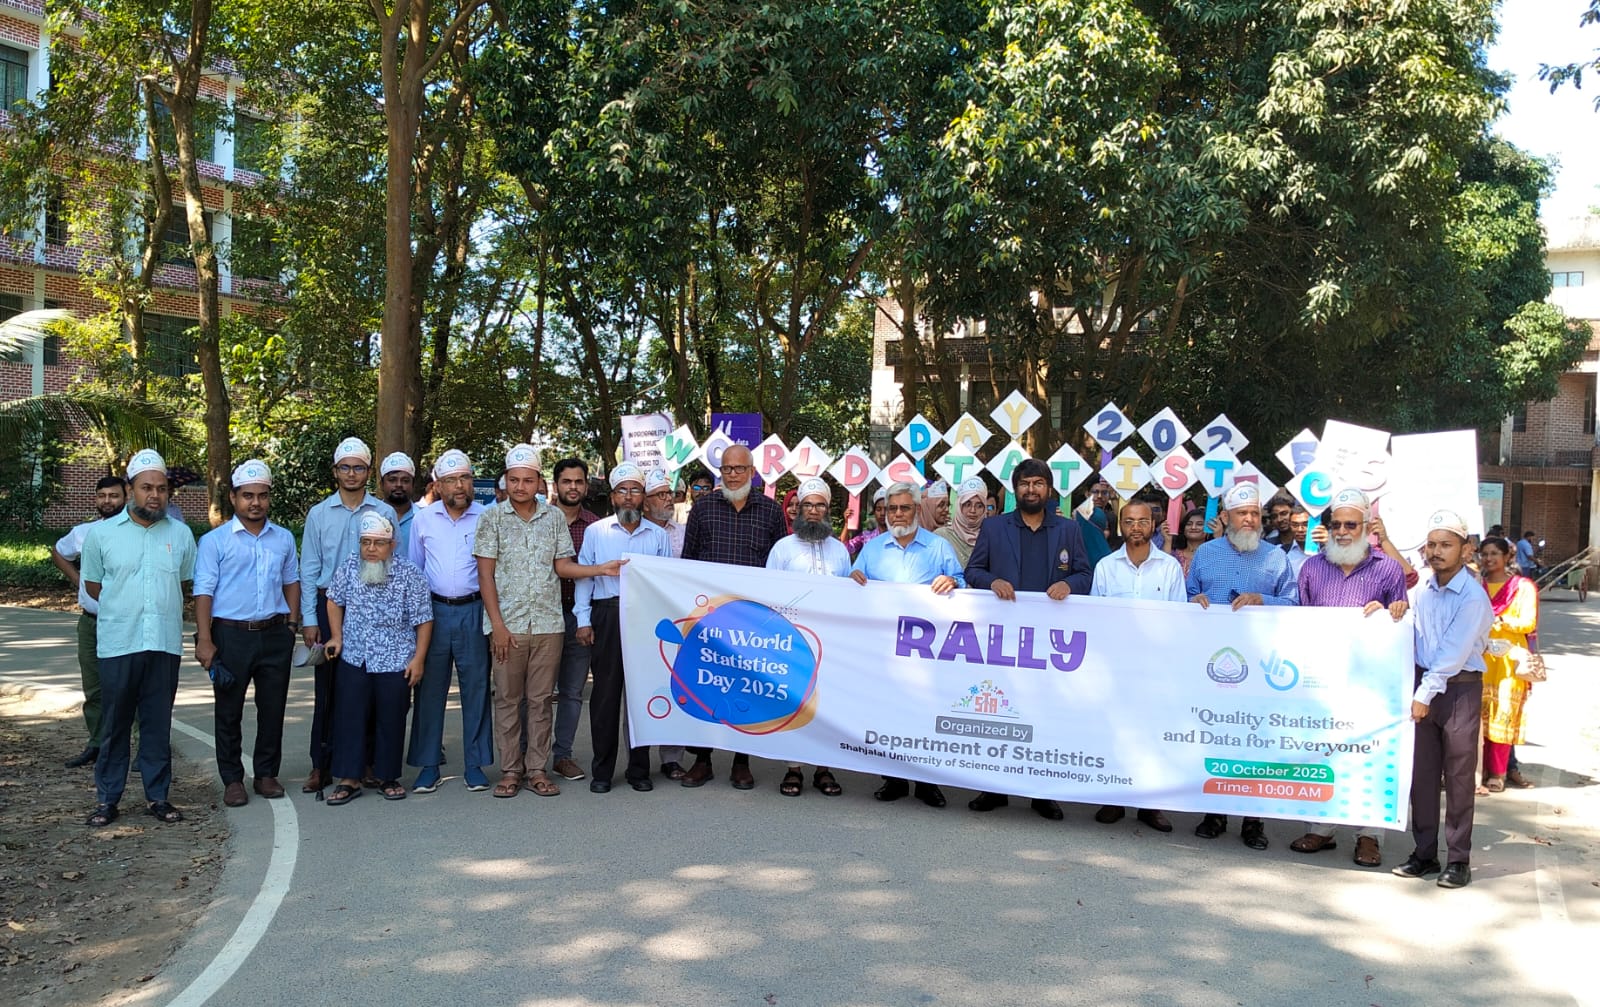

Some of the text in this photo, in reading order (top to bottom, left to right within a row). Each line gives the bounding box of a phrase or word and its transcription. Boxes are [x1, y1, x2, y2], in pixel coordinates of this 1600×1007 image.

[909, 402, 1027, 452] DAY
[697, 626, 793, 652] 4th World
[895, 616, 1087, 672] RALLY
[700, 647, 789, 675] Statistics
[697, 668, 789, 701] Day 2025
[940, 719, 1029, 740] Organized by
[1269, 713, 1356, 731] Statistics
[864, 730, 1105, 769] Department of Statistics
[1163, 731, 1196, 744] and
[1200, 731, 1242, 747] Data
[1246, 734, 1276, 749] for
[840, 742, 1134, 786] Shahjalal University of Science and Technology, Sylhet
[1211, 762, 1328, 779] 20 October 2025
[1215, 781, 1322, 798] Time: 10:00 AM
